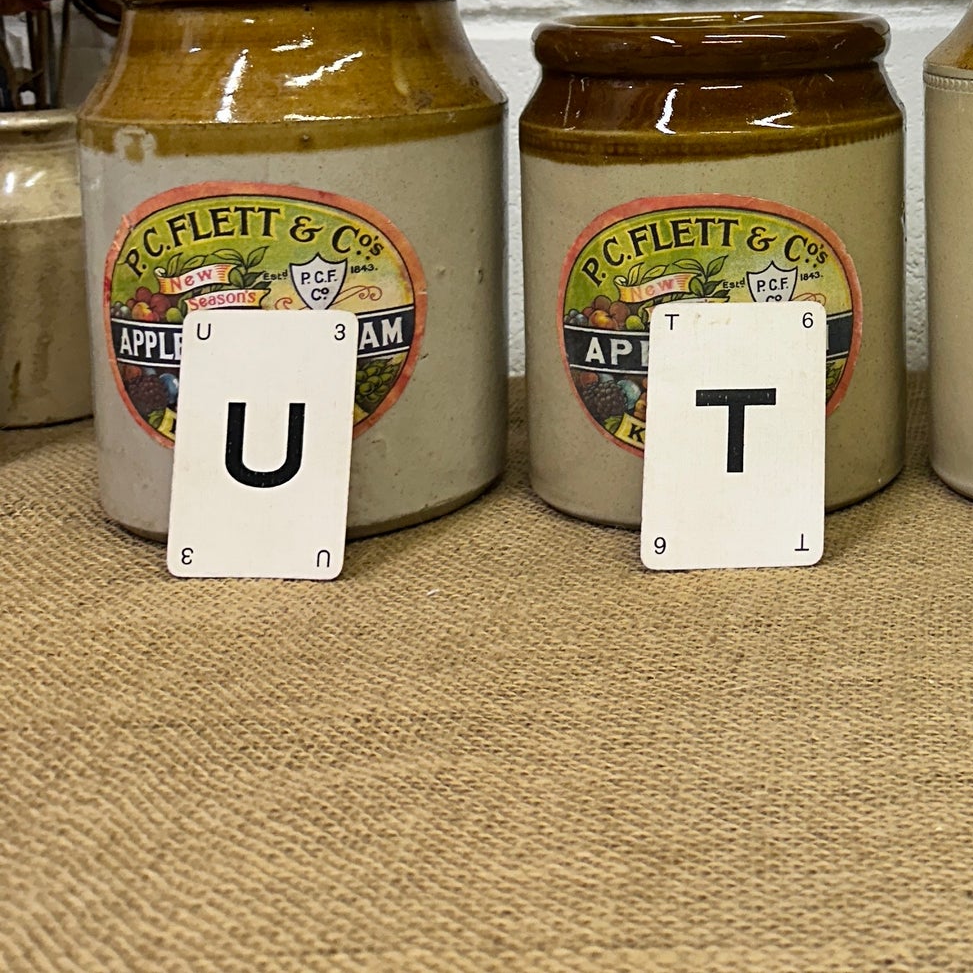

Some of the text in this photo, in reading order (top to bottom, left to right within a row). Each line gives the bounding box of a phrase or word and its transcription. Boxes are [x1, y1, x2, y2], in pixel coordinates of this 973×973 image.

[289, 215, 323, 242] &
[746, 227, 777, 252] &
[188, 288, 257, 311] Season's
[196, 323, 346, 341] U 3
[358, 317, 404, 350] AM
[664, 312, 814, 330] T 6
[695, 388, 776, 472] T
[225, 402, 306, 488] U
